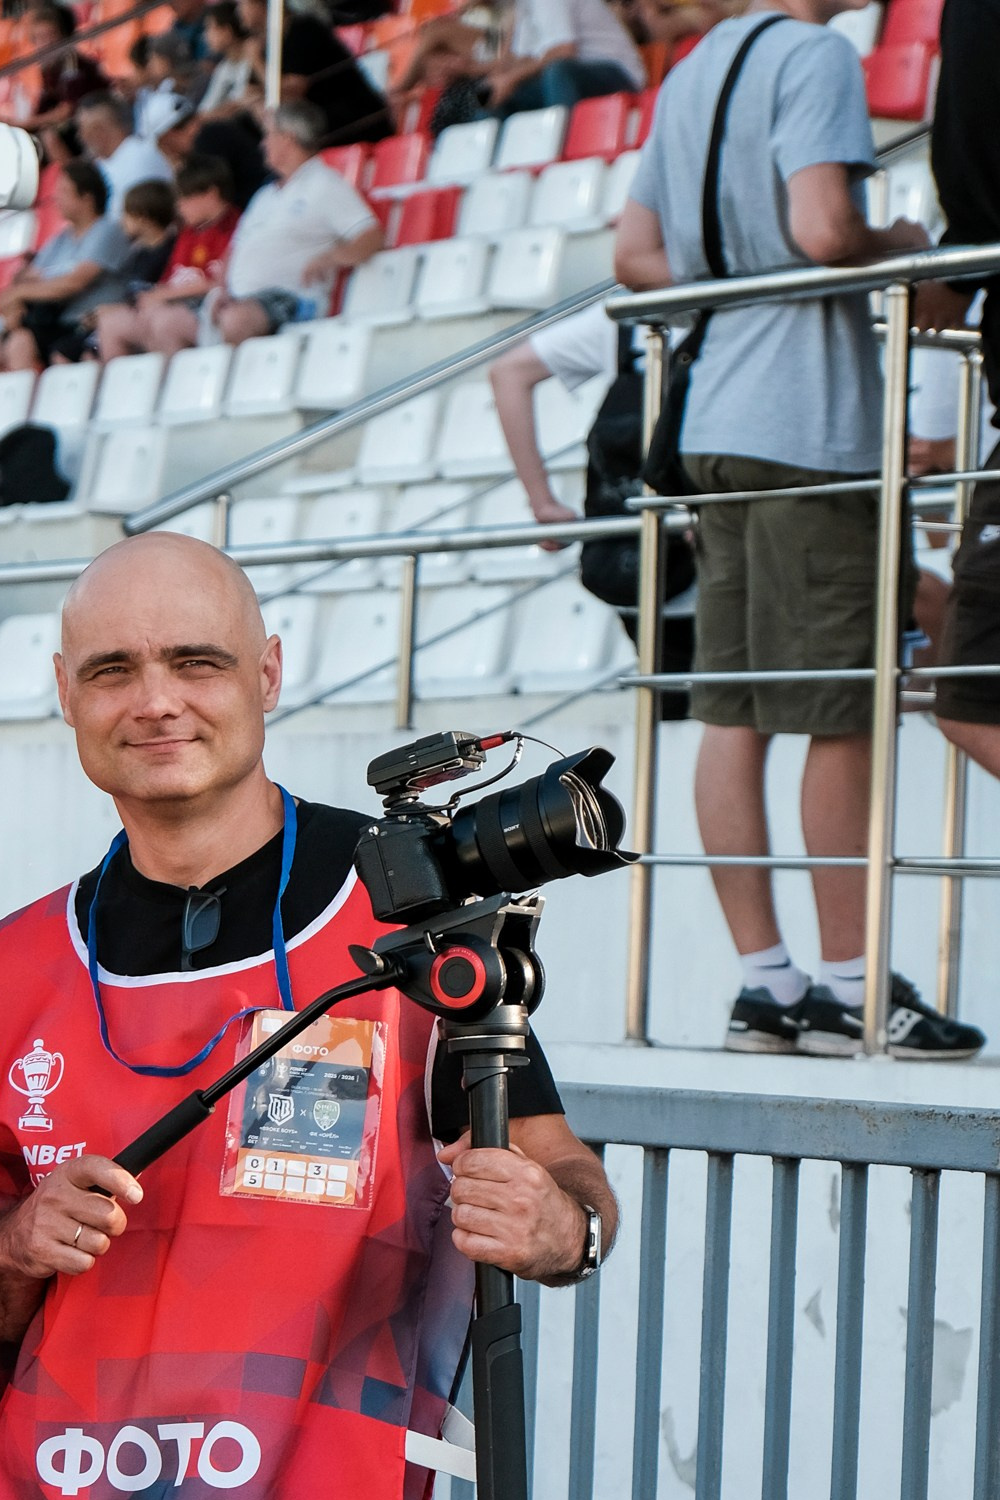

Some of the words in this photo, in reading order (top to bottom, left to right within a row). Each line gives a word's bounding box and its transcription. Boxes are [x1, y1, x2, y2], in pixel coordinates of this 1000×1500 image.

[292, 1044, 329, 1056] ФОТО
[22, 1141, 87, 1166] NBET
[251, 1159, 259, 1169] 0
[273, 1161, 278, 1171] 1
[313, 1165, 321, 1175] 3
[249, 1175, 257, 1185] 5
[36, 1420, 262, 1496] ФОТО
